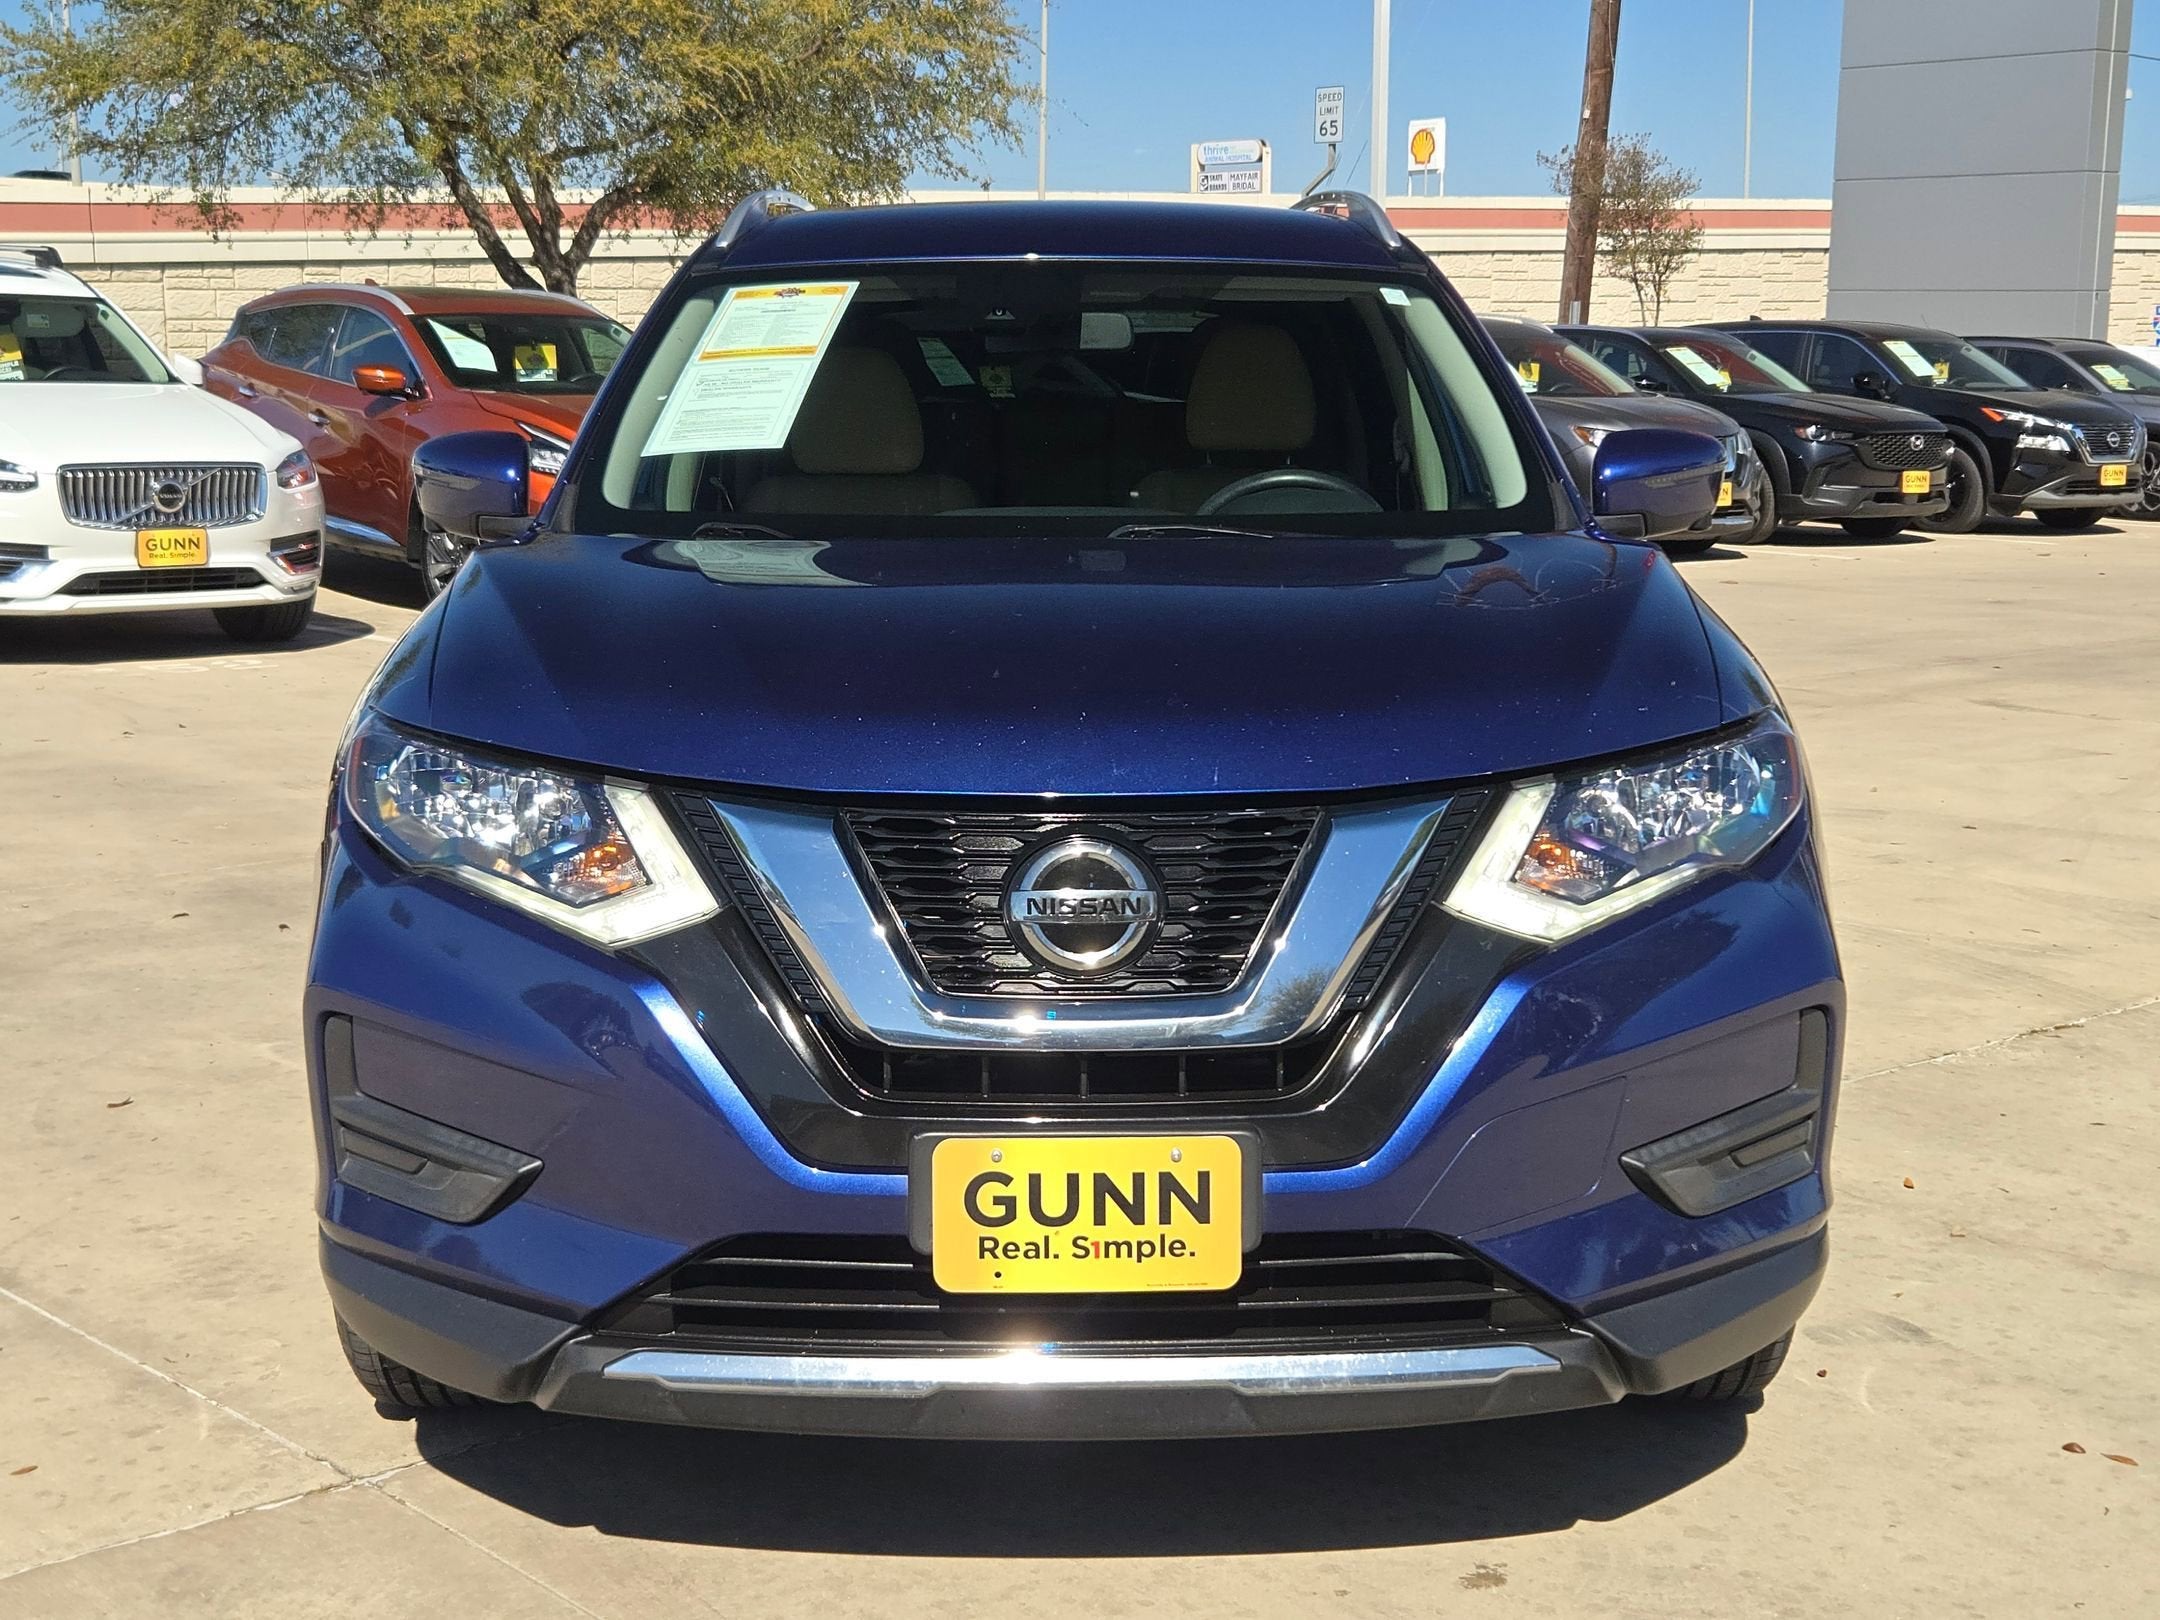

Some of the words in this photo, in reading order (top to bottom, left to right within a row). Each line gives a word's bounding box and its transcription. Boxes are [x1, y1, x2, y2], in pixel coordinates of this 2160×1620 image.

[1317, 92, 1342, 103] SPEED
[1319, 106, 1339, 116] LIMIT
[1319, 120, 1338, 136] 65
[1203, 144, 1229, 156] thrive
[1209, 173, 1223, 182] SKATE
[1230, 172, 1259, 181] MAYFAIR
[1209, 183, 1227, 192] BOARDS
[1232, 181, 1256, 191] BRIDAL
[2103, 469, 2124, 478] GUNN
[1905, 474, 1927, 484] GUNN
[145, 537, 200, 551] GUNN
[1026, 897, 1141, 915] NISSAN
[963, 1170, 1211, 1228] GUNN
[978, 1235, 1060, 1260] Real.
